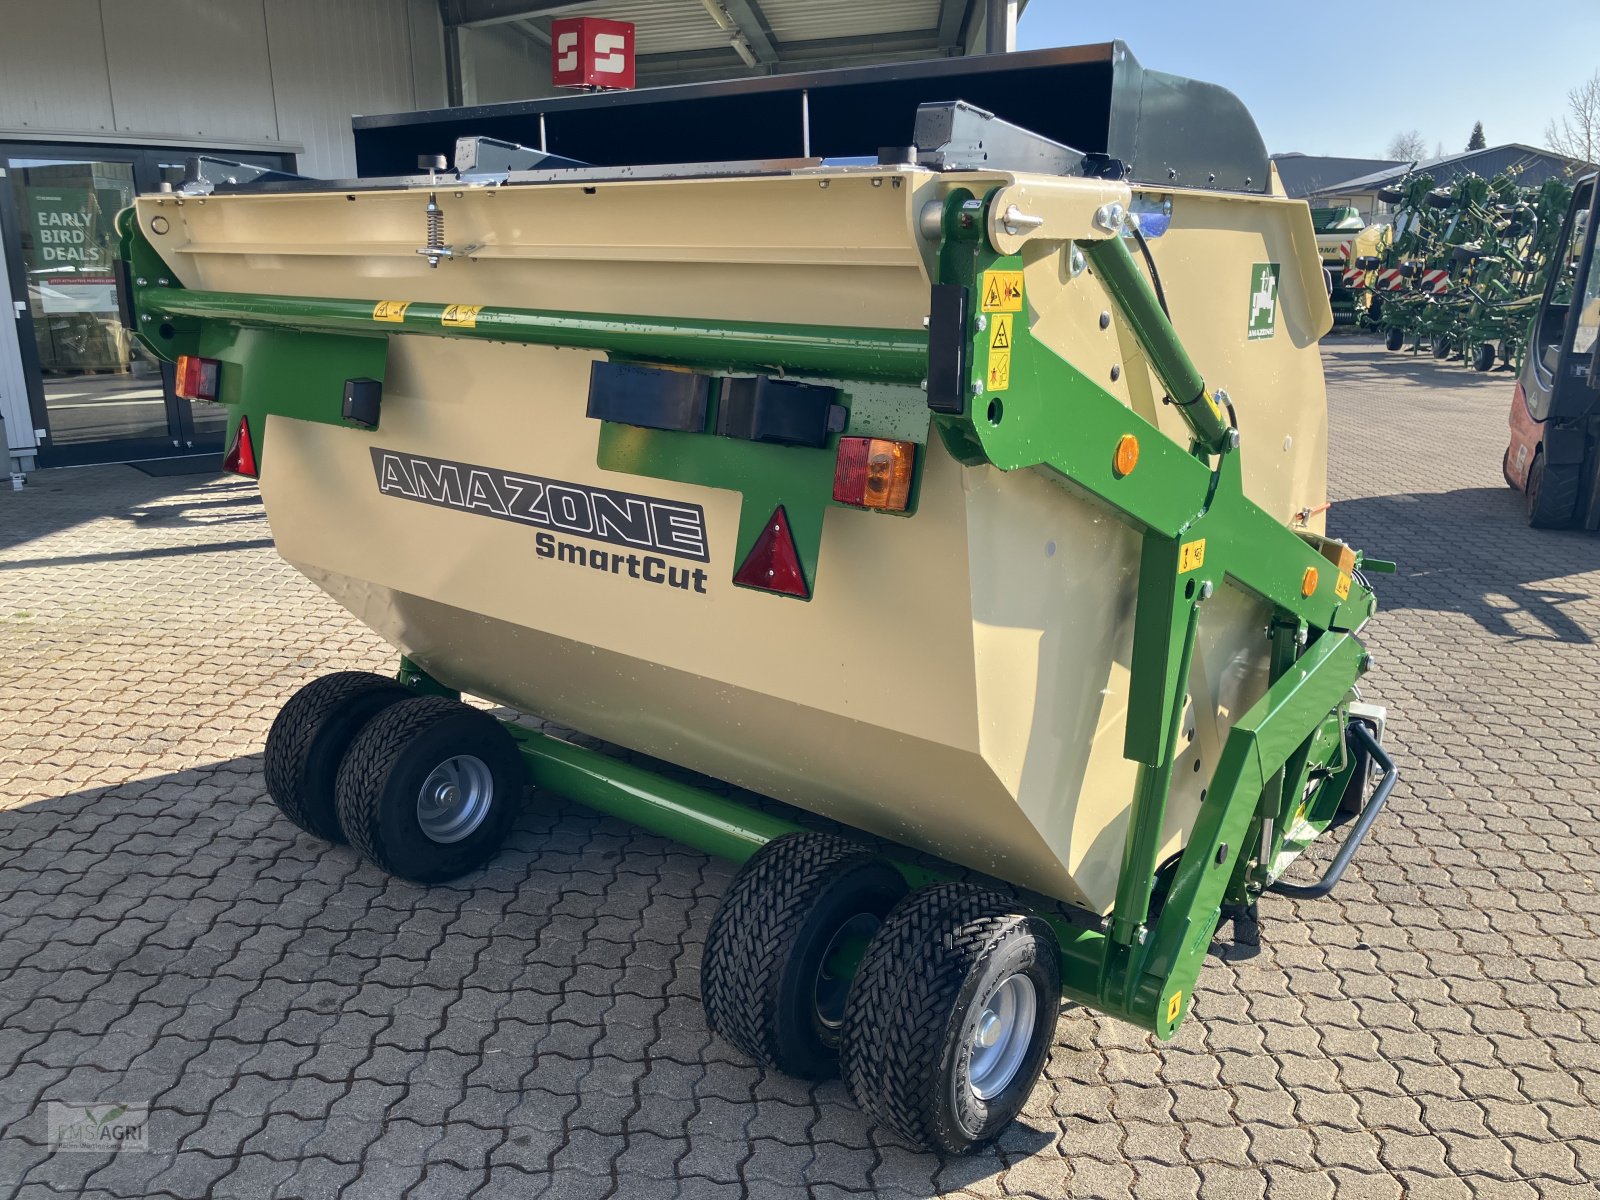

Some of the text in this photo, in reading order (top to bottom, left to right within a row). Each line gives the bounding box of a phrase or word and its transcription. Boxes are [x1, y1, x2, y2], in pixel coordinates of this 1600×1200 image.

[38, 212, 92, 226] EARLY
[40, 229, 85, 243] BIRD
[43, 247, 100, 261] DEALS
[1248, 327, 1274, 336] AMAZONE
[381, 454, 705, 557] AMAZONE
[535, 532, 708, 595] SmartCut
